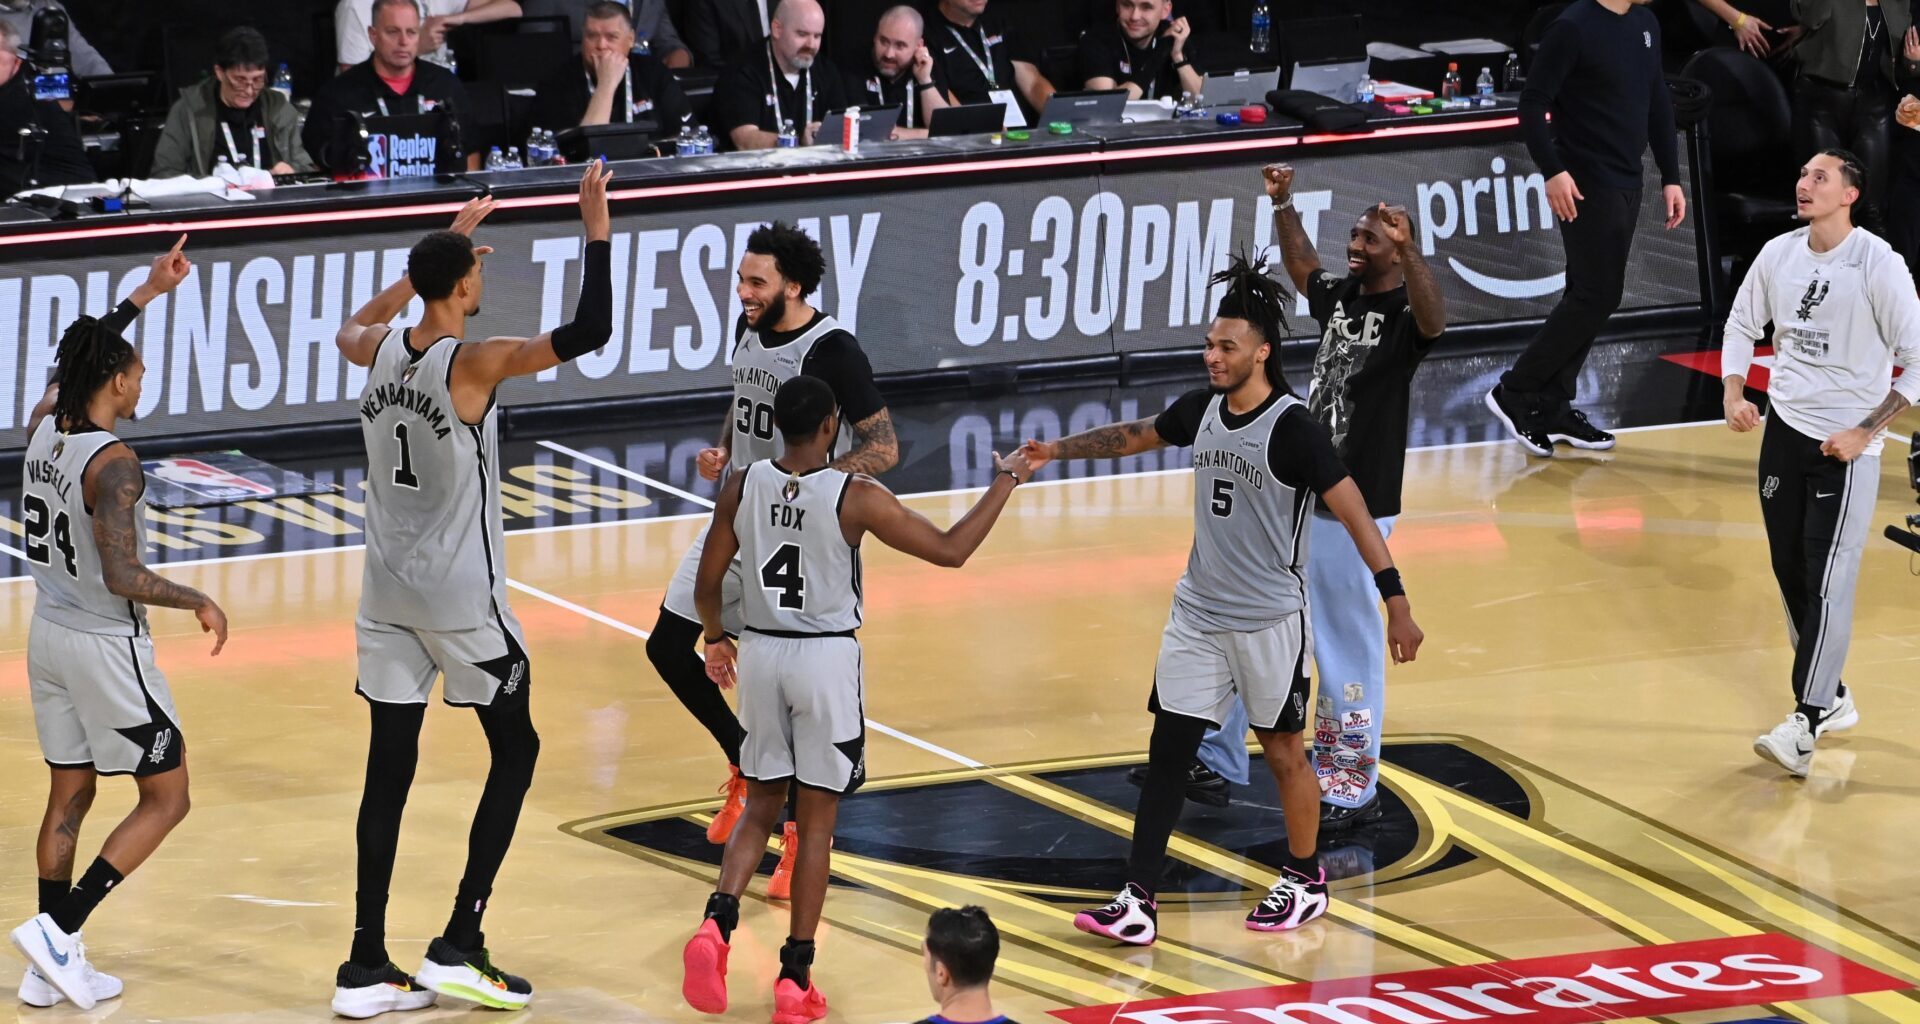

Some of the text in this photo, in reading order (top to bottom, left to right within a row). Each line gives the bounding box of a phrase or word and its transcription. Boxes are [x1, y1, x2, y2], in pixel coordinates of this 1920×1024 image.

[390, 133, 436, 163] Replay
[954, 191, 1235, 347] 8:30PM
[361, 382, 451, 440] WEMBANYAMA
[736, 396, 775, 441] 30
[392, 421, 420, 490] 1
[1212, 449, 1264, 492] ANTONIO
[27, 459, 72, 504] VASSELL
[1210, 477, 1235, 518] 5
[23, 492, 78, 580] 24
[770, 503, 805, 531] FOX
[759, 541, 805, 612] 4
